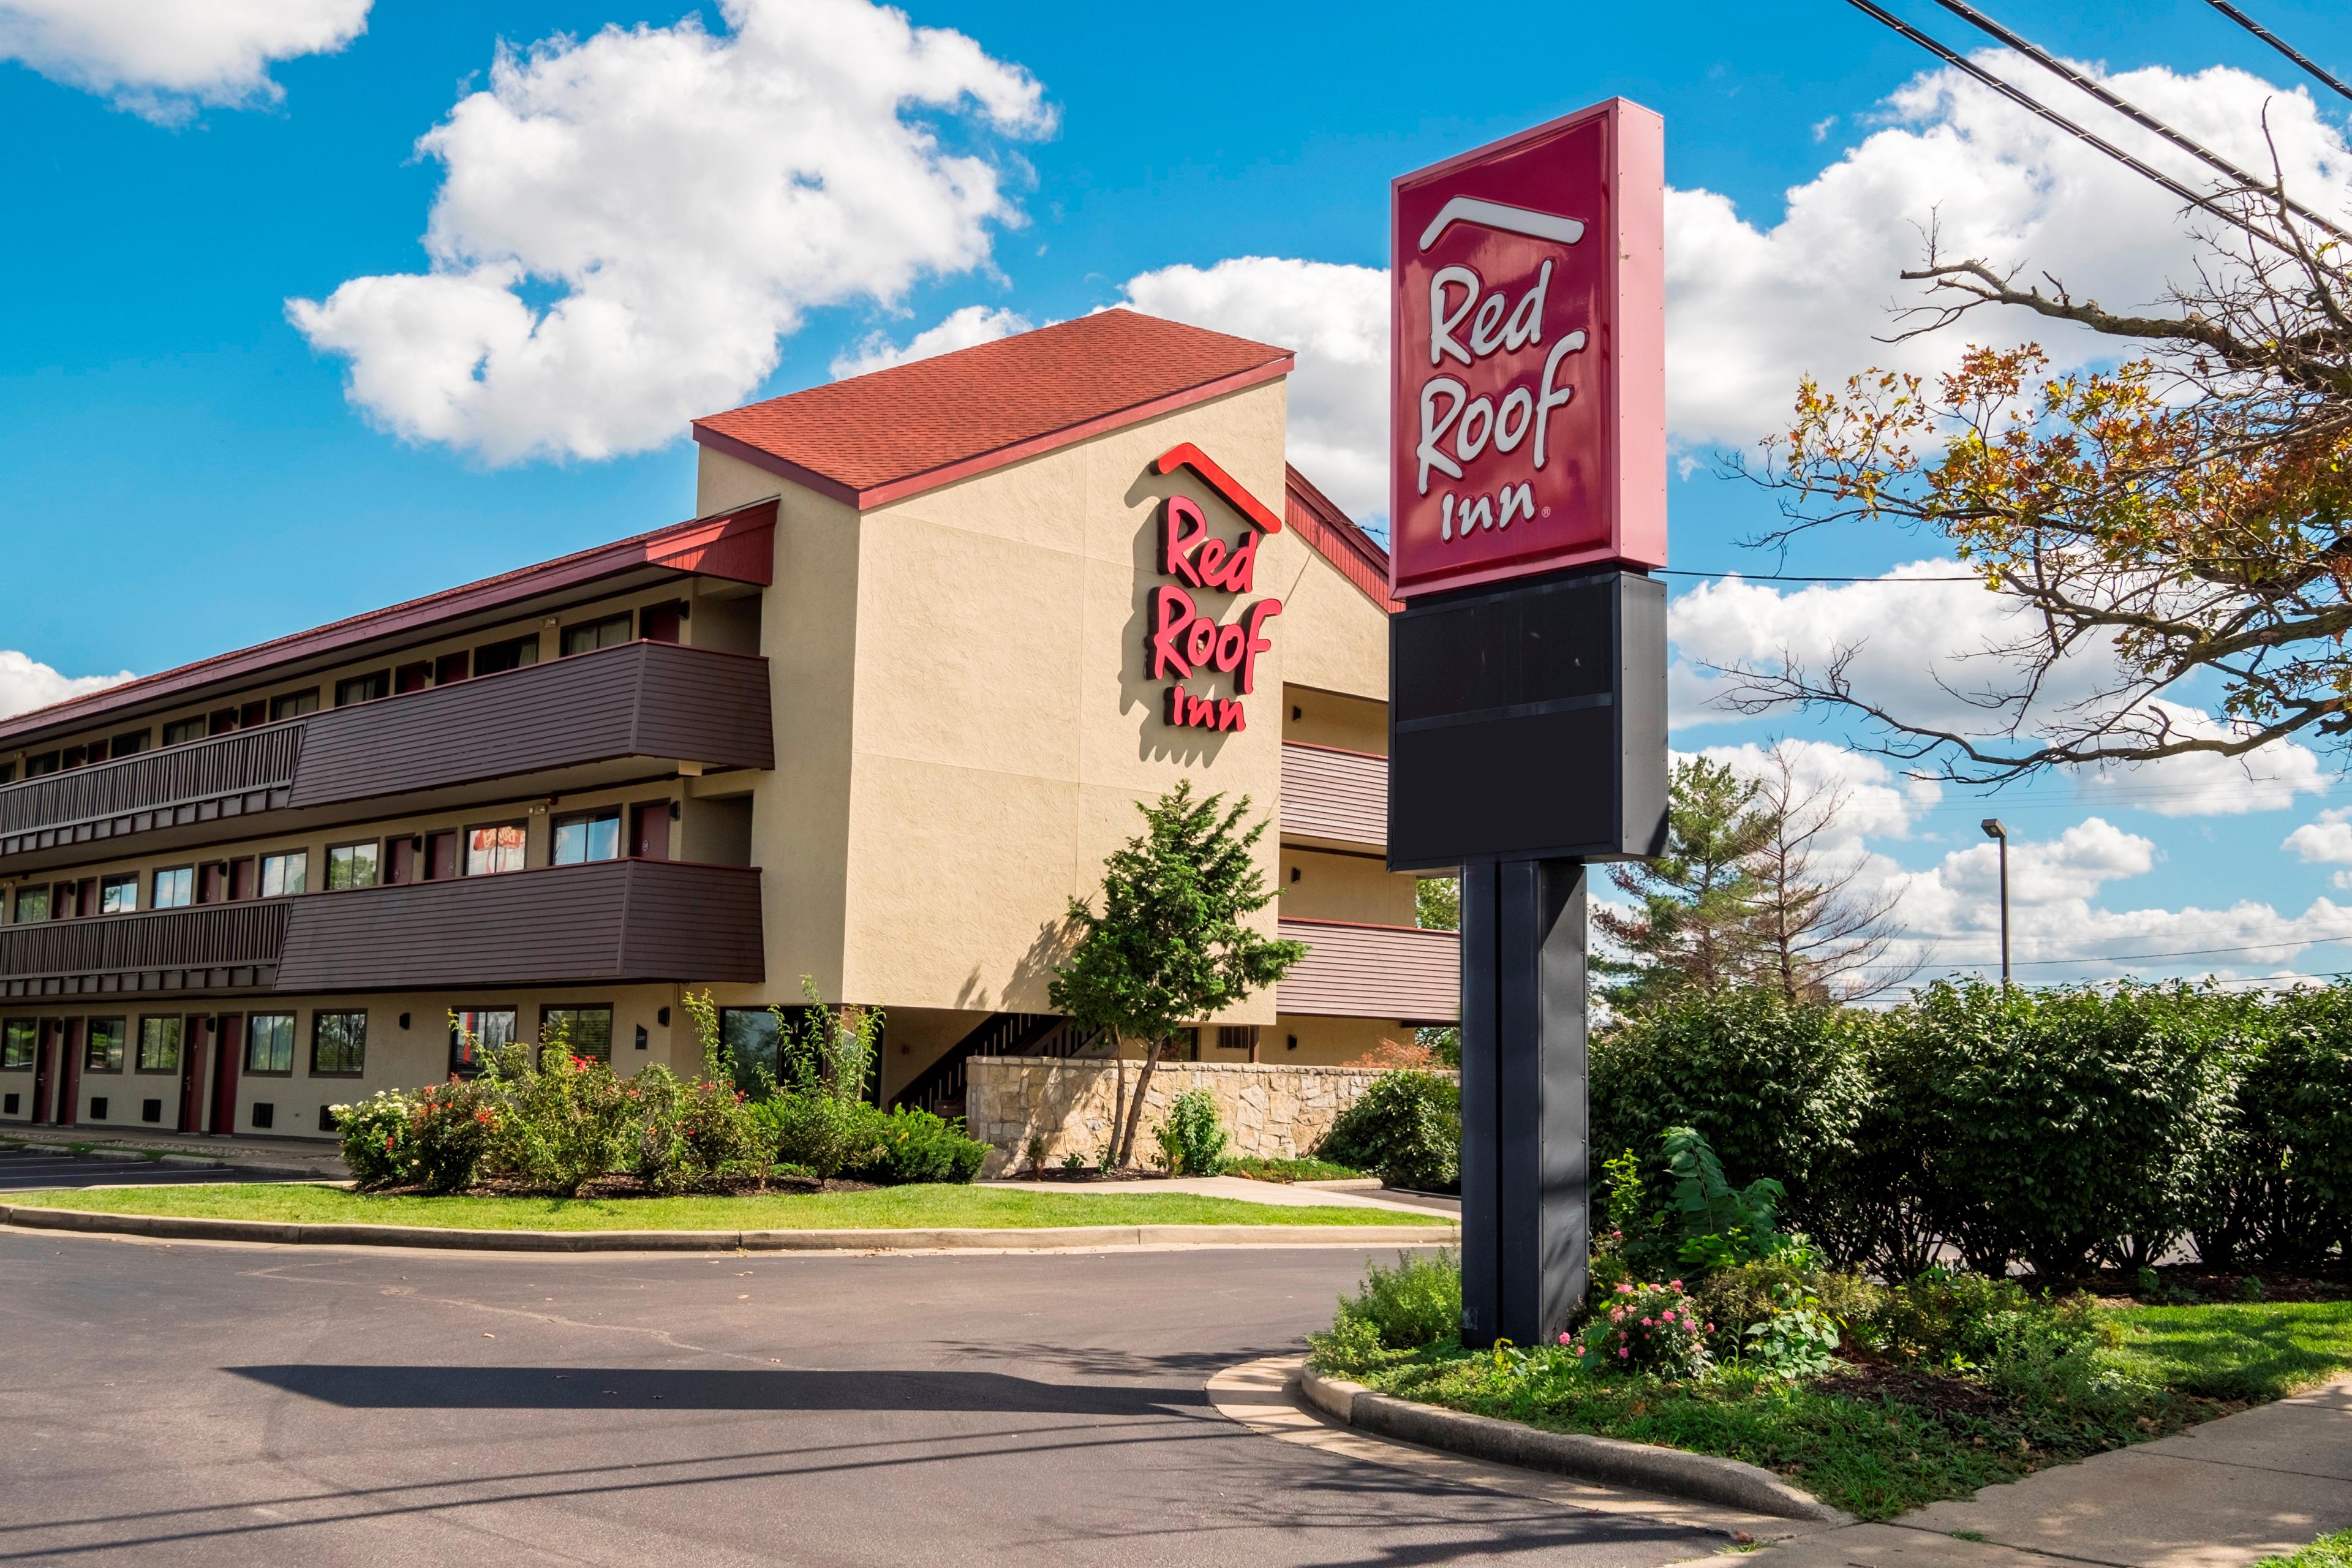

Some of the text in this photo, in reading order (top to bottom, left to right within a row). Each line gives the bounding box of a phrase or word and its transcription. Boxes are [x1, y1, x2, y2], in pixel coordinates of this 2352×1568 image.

[1430, 260, 1553, 364] Red
[1415, 330, 1586, 494] Roof
[1164, 494, 1259, 595] Red
[1441, 483, 1535, 540] Inn
[1150, 584, 1283, 696] Roof
[1170, 685, 1247, 733] Inn
